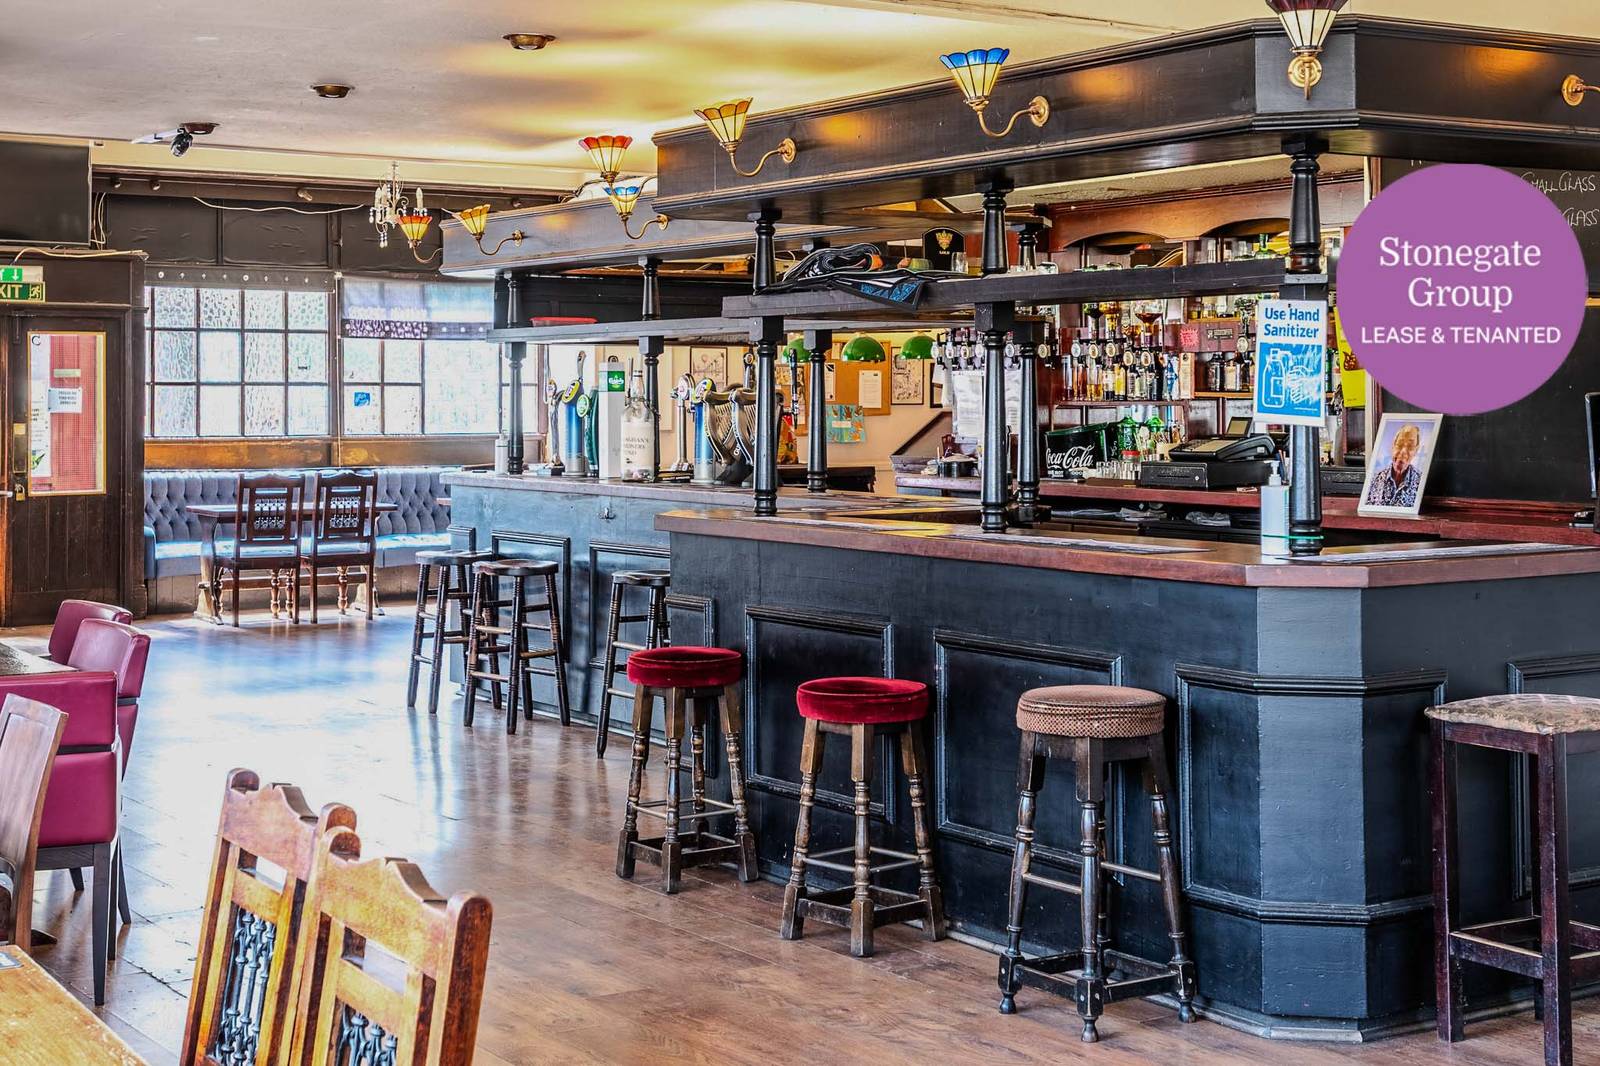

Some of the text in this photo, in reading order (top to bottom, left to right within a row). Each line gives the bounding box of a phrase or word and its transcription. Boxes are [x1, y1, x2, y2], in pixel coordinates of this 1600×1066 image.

[1559, 171, 1596, 193] GLASS
[1265, 307, 1320, 322] Use Hand
[1263, 323, 1319, 338] Sanitizer
